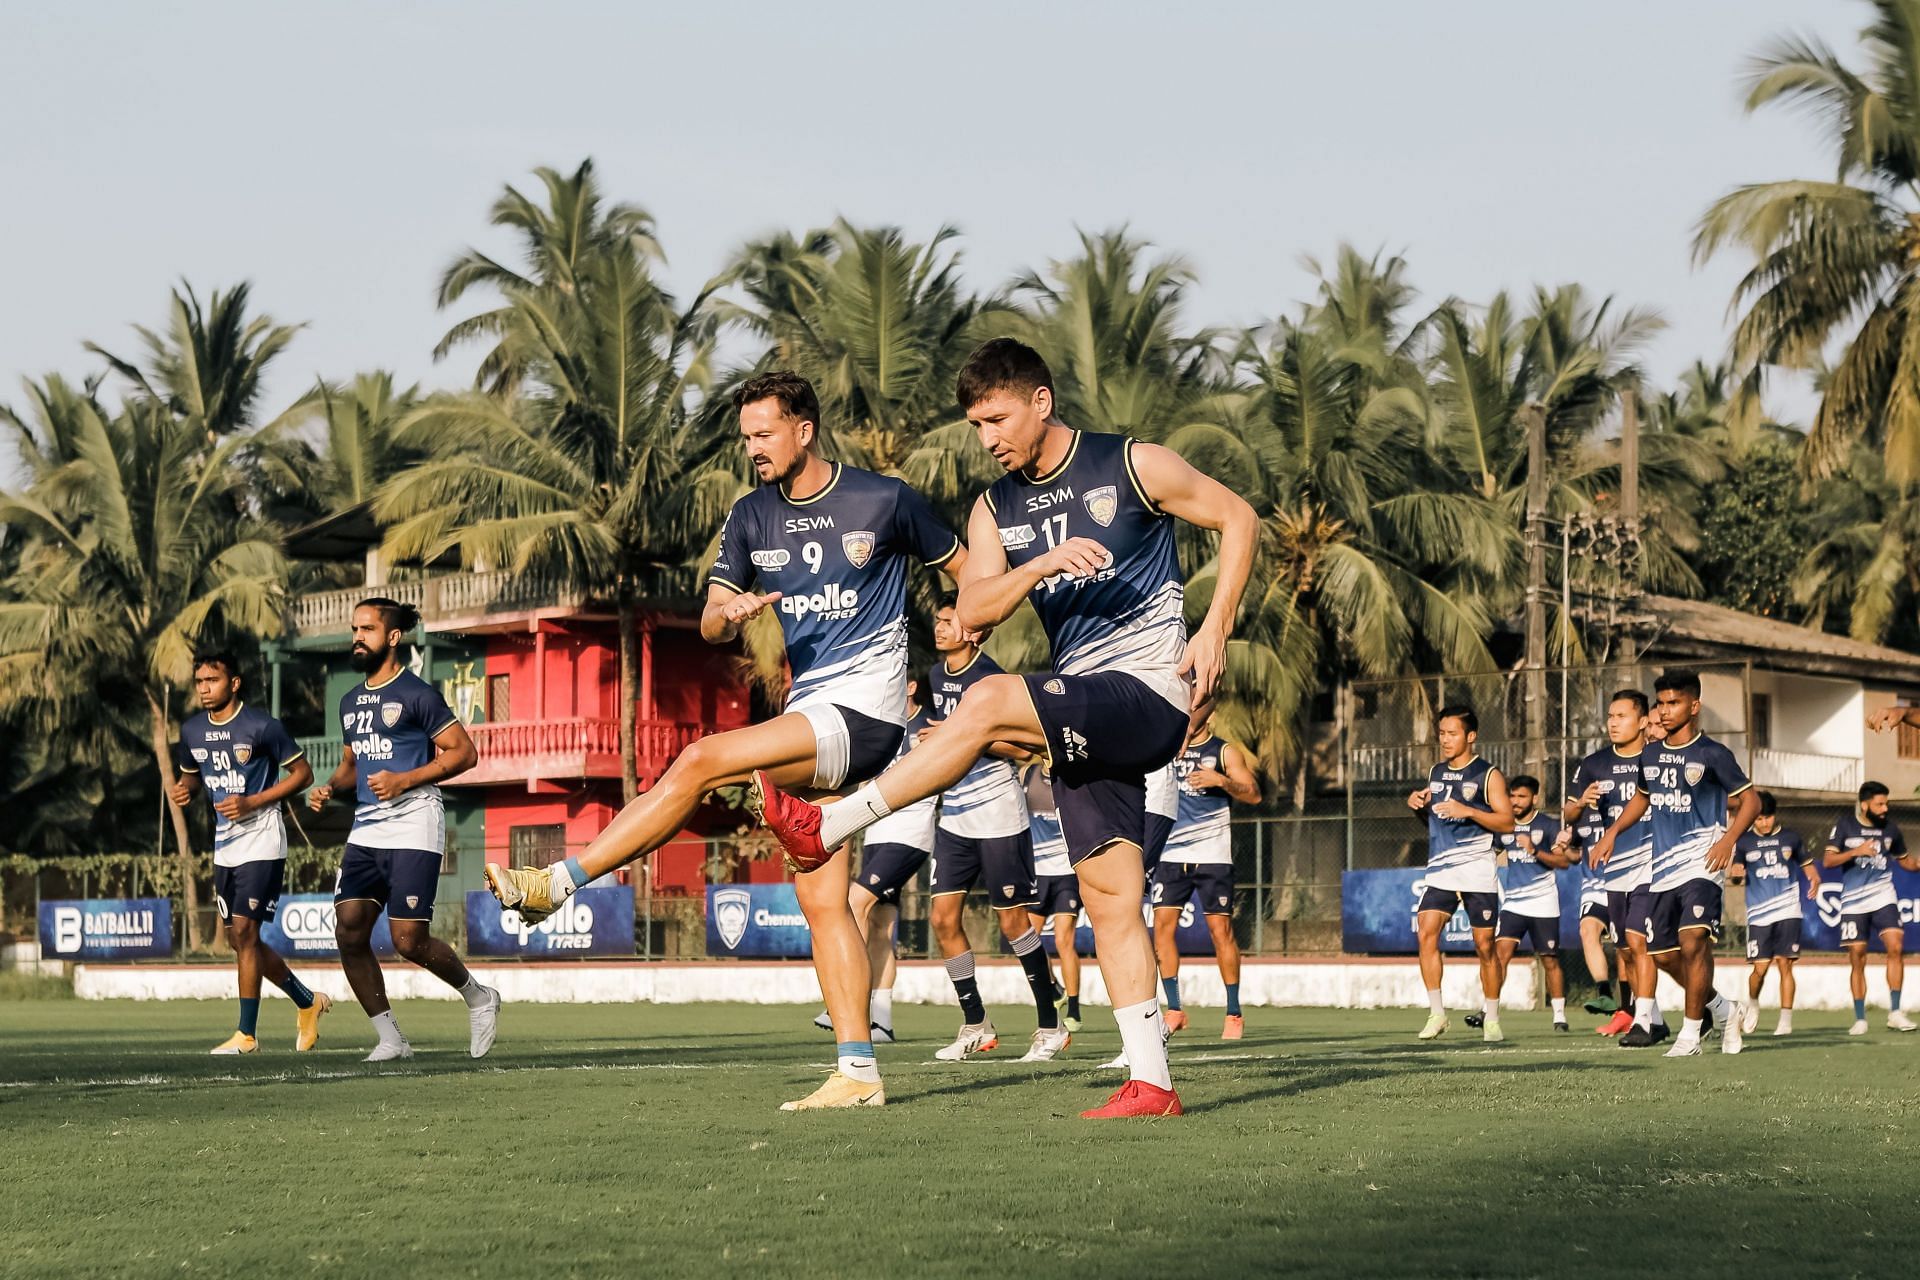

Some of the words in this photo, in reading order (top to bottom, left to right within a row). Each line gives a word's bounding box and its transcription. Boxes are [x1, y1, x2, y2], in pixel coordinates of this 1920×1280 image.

[1026, 486, 1075, 513] SSVM
[785, 516, 835, 534] SSVM
[1041, 512, 1068, 551] 17
[801, 541, 824, 575] 9
[1073, 568, 1116, 591] TYRES
[781, 583, 859, 622] apollo
[816, 607, 859, 622] TYRES
[356, 694, 381, 706] SSVM
[357, 709, 374, 735] 22
[205, 731, 231, 742] SSVM
[212, 750, 231, 771] 50
[1659, 753, 1685, 766] SSVM
[1660, 767, 1678, 789] 43
[1619, 781, 1636, 801] 18
[1650, 789, 1692, 811] apollo
[1764, 850, 1778, 865] 15
[1841, 920, 1859, 940] 28
[547, 934, 592, 949] TYRES
[1747, 940, 1759, 959] 15
